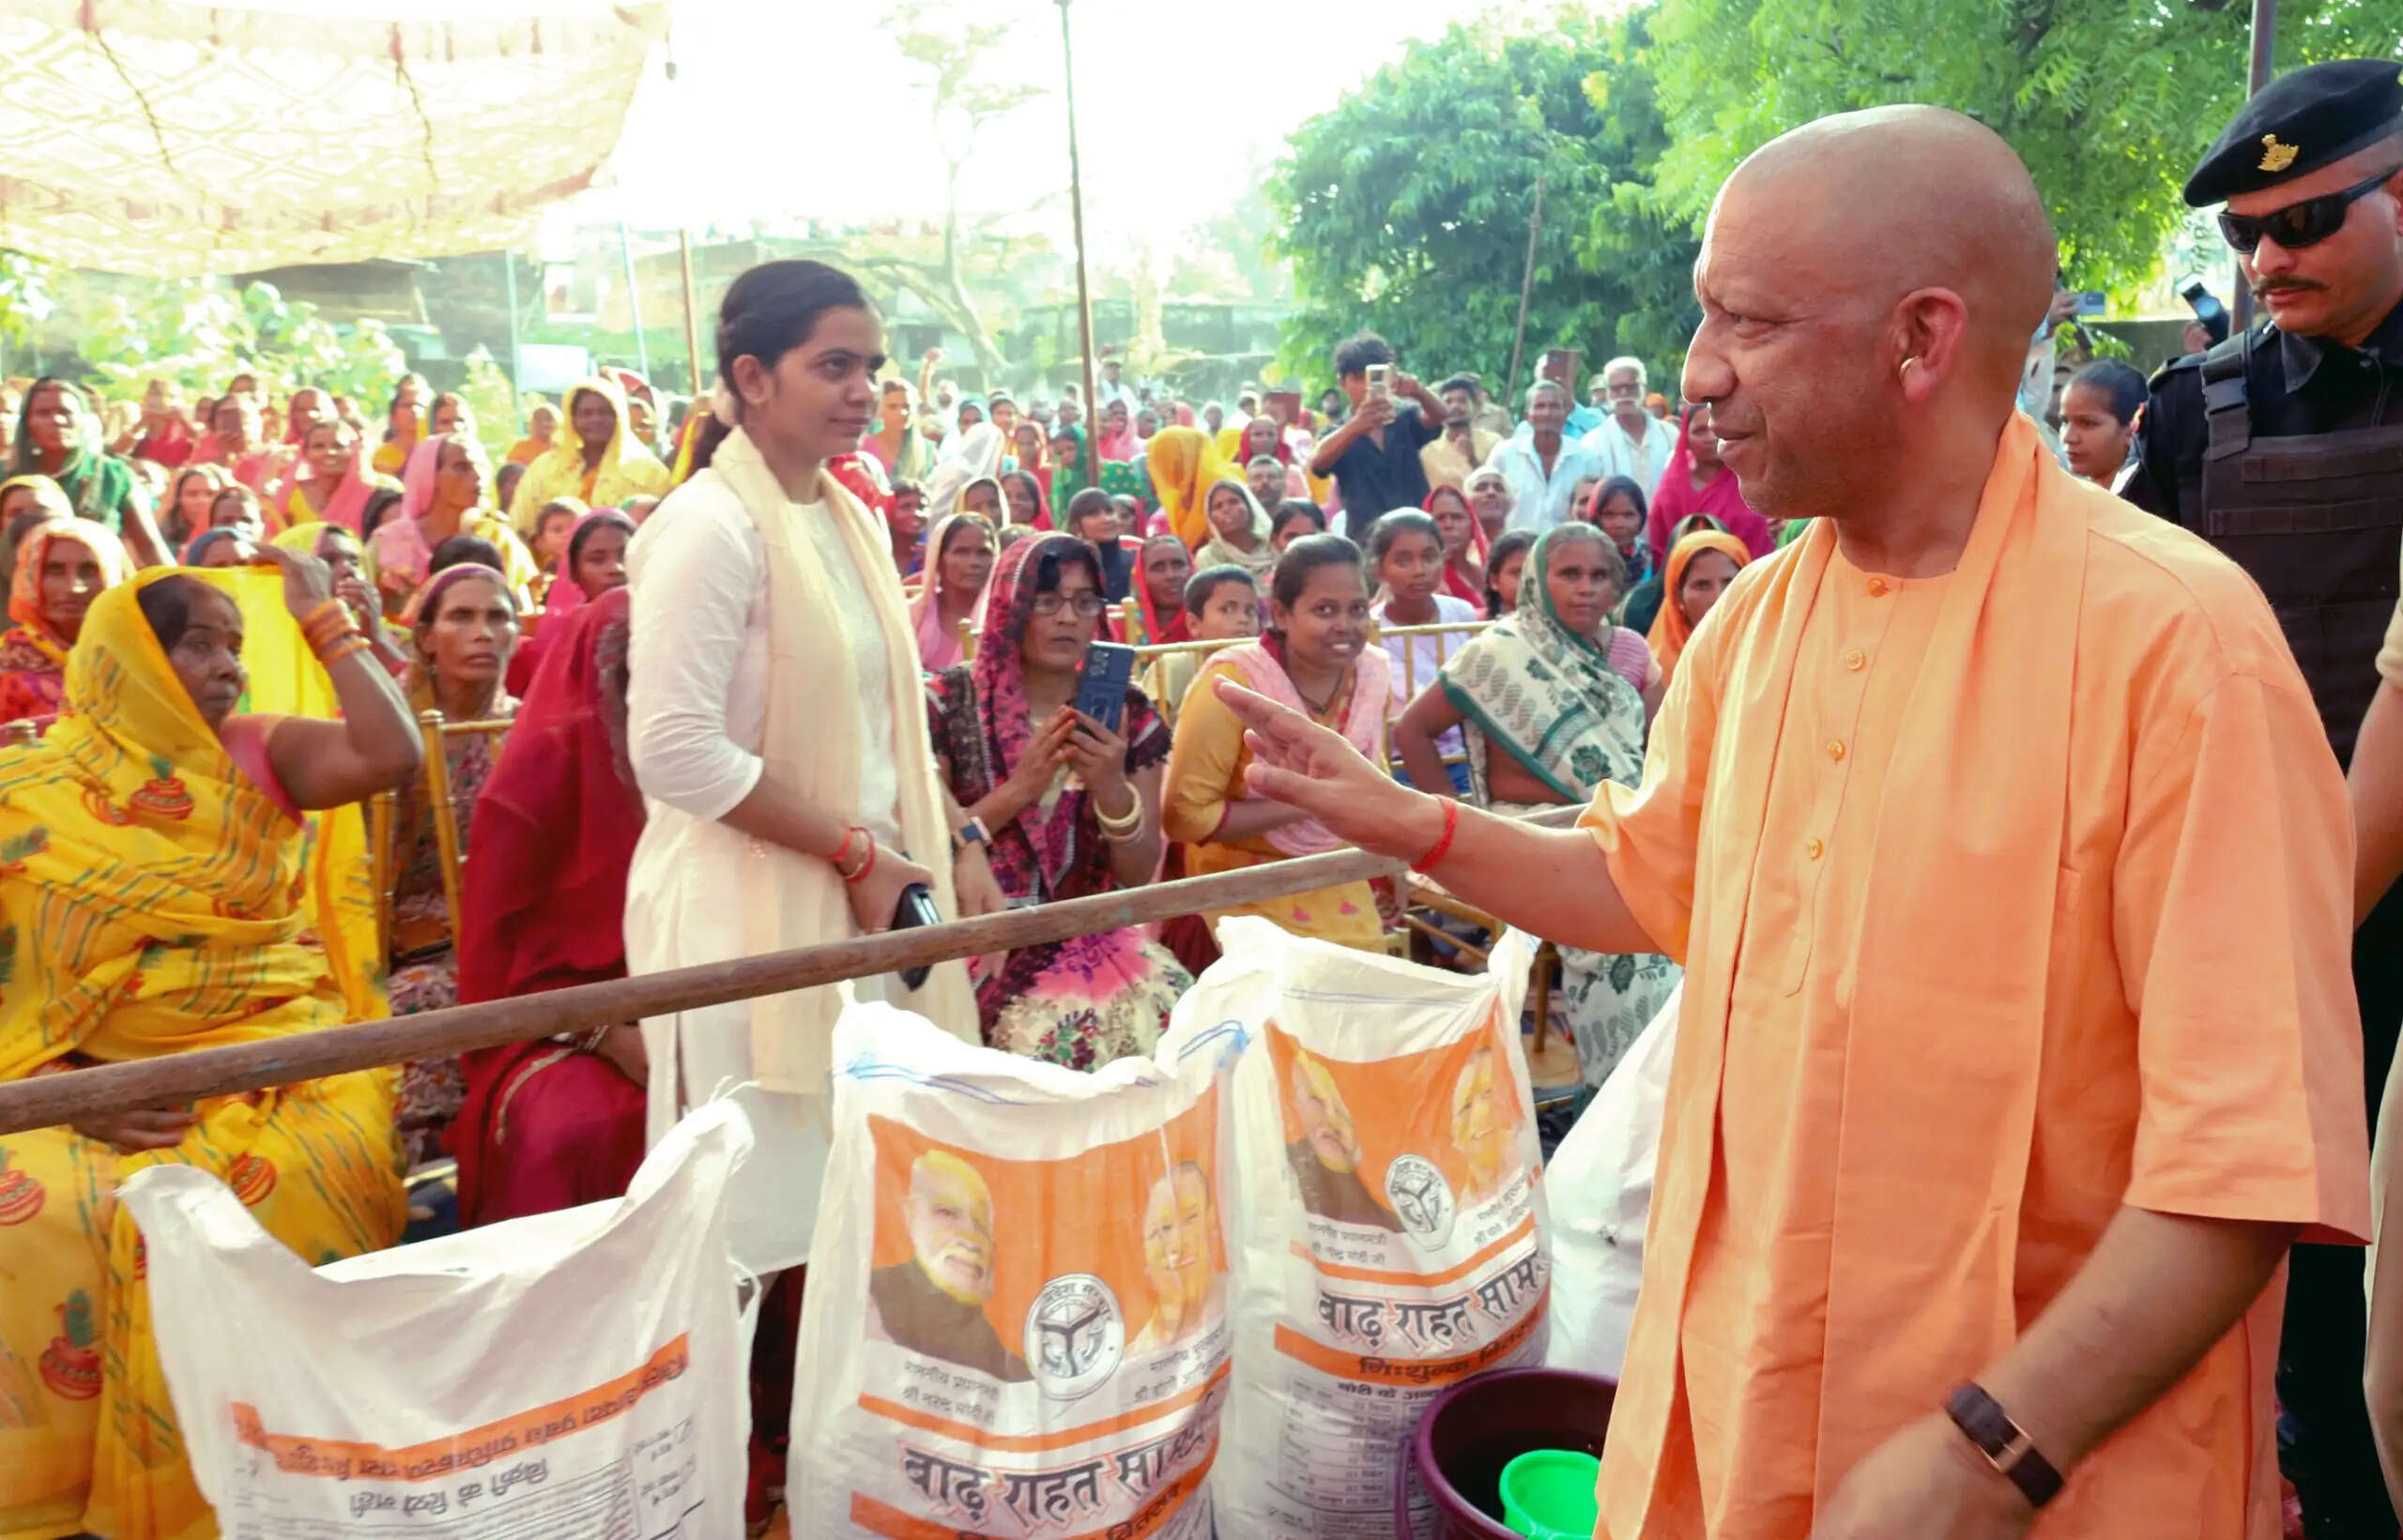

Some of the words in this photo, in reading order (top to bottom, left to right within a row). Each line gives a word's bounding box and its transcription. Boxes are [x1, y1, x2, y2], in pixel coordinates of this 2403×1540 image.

[1395, 1296, 1474, 1349] राहत
[456, 1481, 484, 1507] के
[1003, 1460, 1106, 1529] राहत
